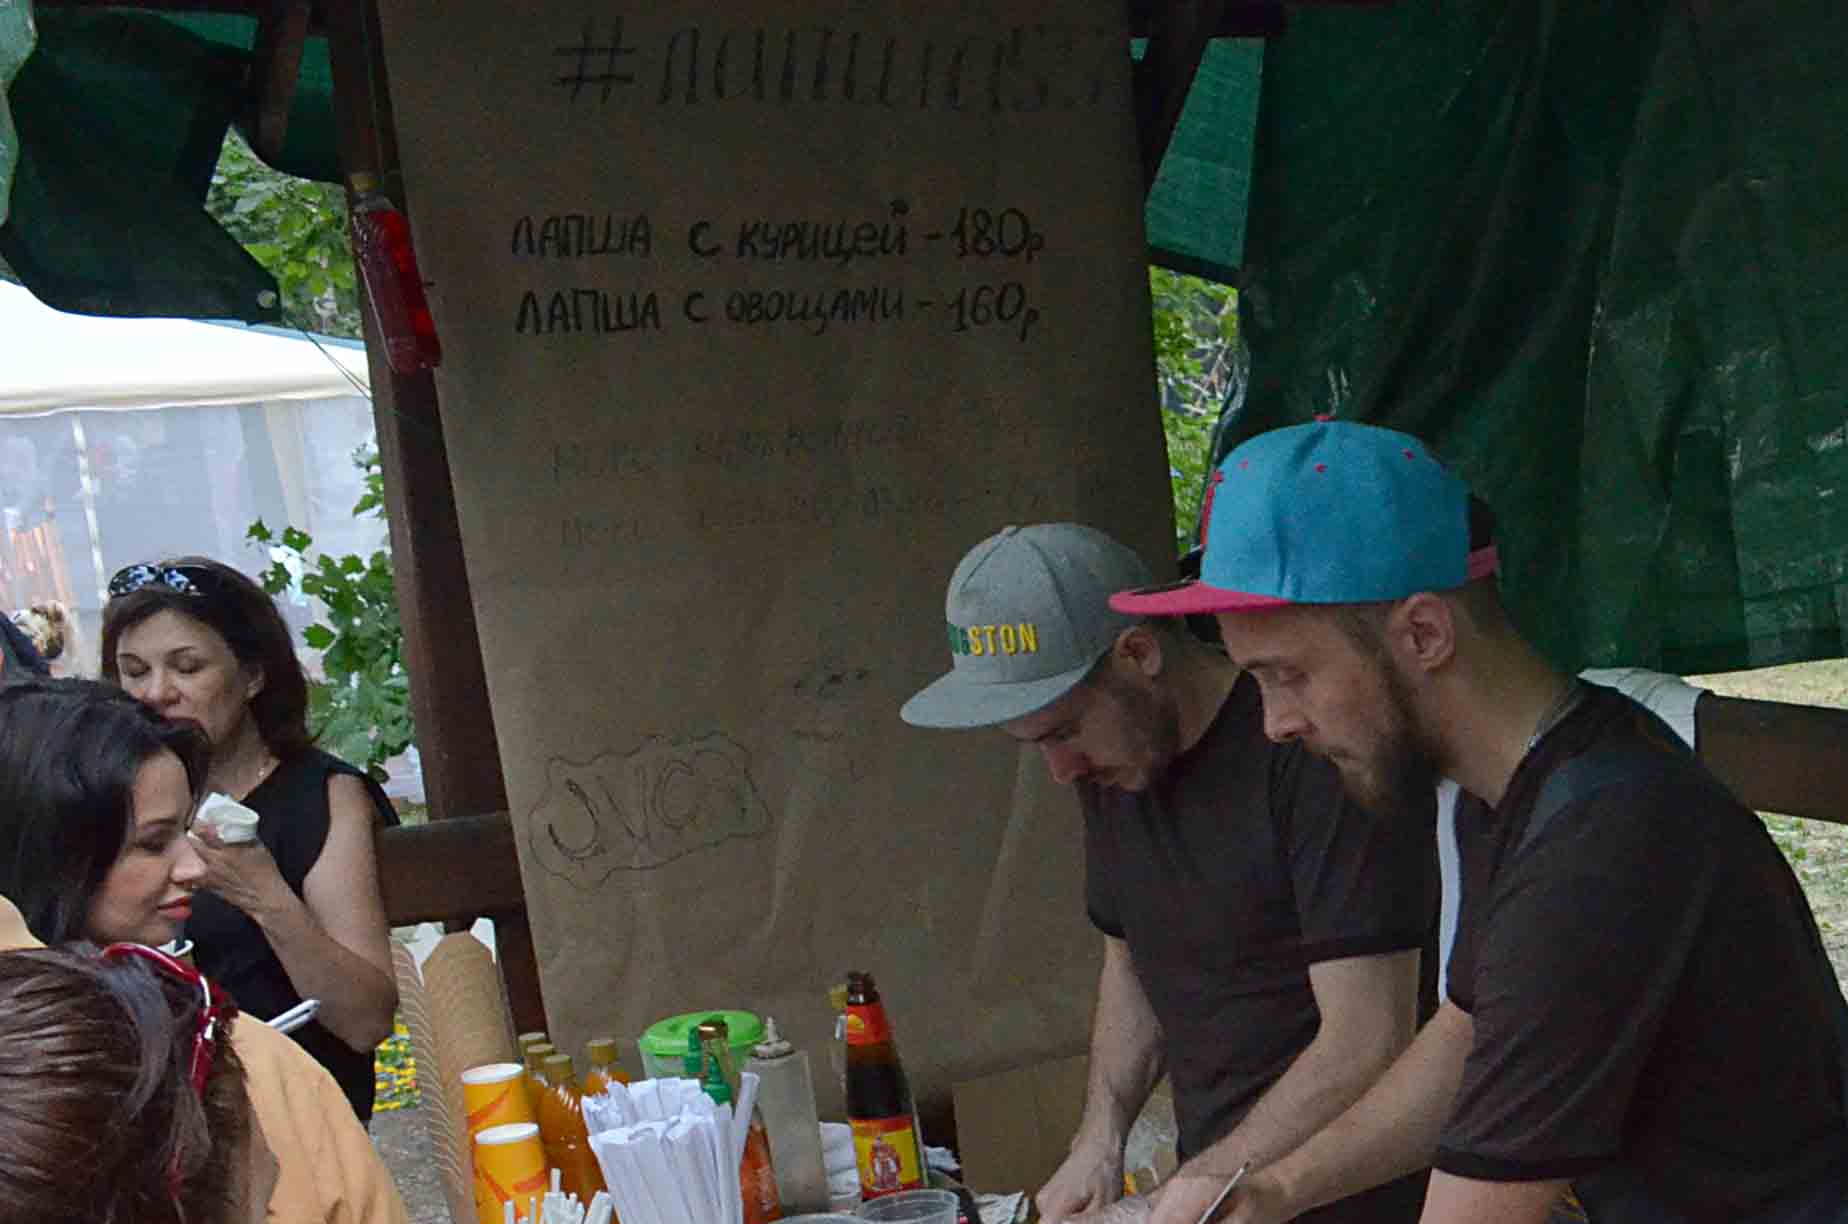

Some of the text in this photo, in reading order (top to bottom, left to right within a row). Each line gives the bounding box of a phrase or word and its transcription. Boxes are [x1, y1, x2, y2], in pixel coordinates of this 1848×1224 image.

[510, 213, 652, 259] ЛАПША
[687, 218, 722, 259] С
[515, 288, 662, 336] ЛАПША
[683, 290, 711, 324] С
[726, 286, 905, 336] ОВОЩАМИ
